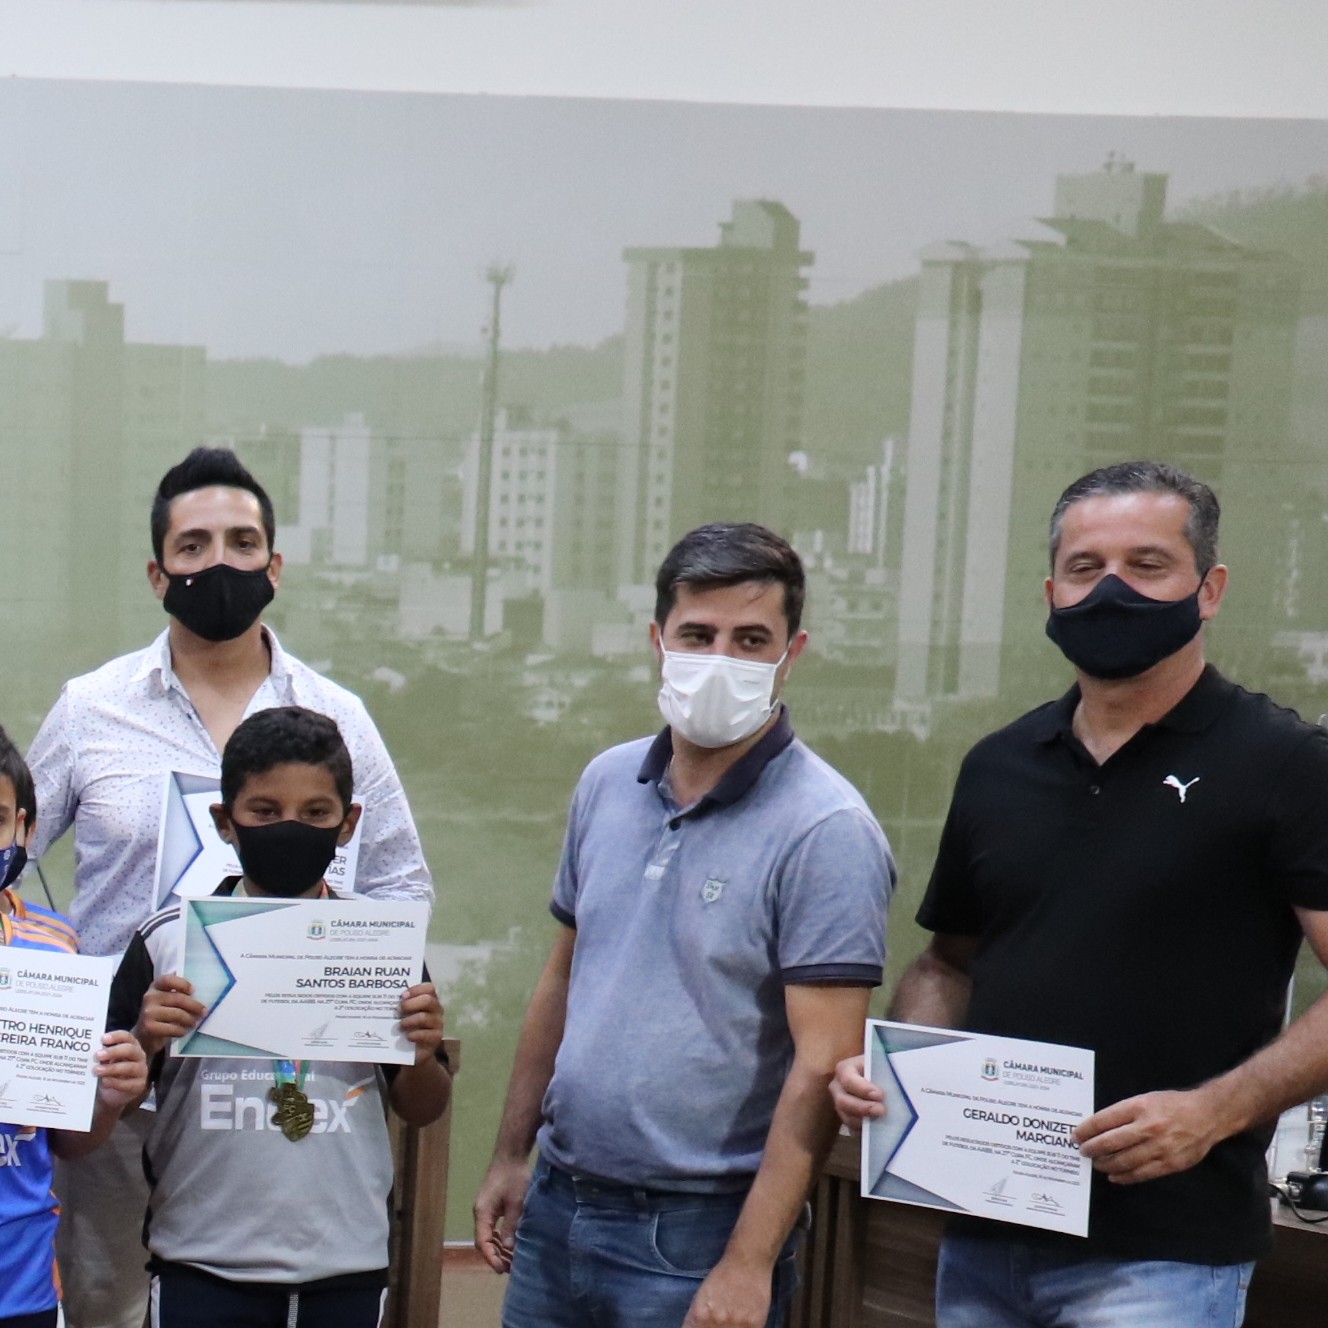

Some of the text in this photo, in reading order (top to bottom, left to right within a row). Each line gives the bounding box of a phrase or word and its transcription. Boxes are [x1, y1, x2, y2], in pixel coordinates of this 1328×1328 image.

[331, 919, 368, 928] CÂMARA
[17, 970, 98, 987] CÂMARA MUNICIPAL
[324, 967, 410, 976] BRAIAN RUAN
[296, 979, 409, 989] SANTOS BARBOSA
[29, 1023, 92, 1040] HENRIQUE
[40, 1036, 90, 1052] FRANCO
[201, 1070, 237, 1083] Grupo
[1004, 1060, 1083, 1080] CÂMARA MUNICIPAL
[963, 1108, 1077, 1134] GERALDO DONIZET
